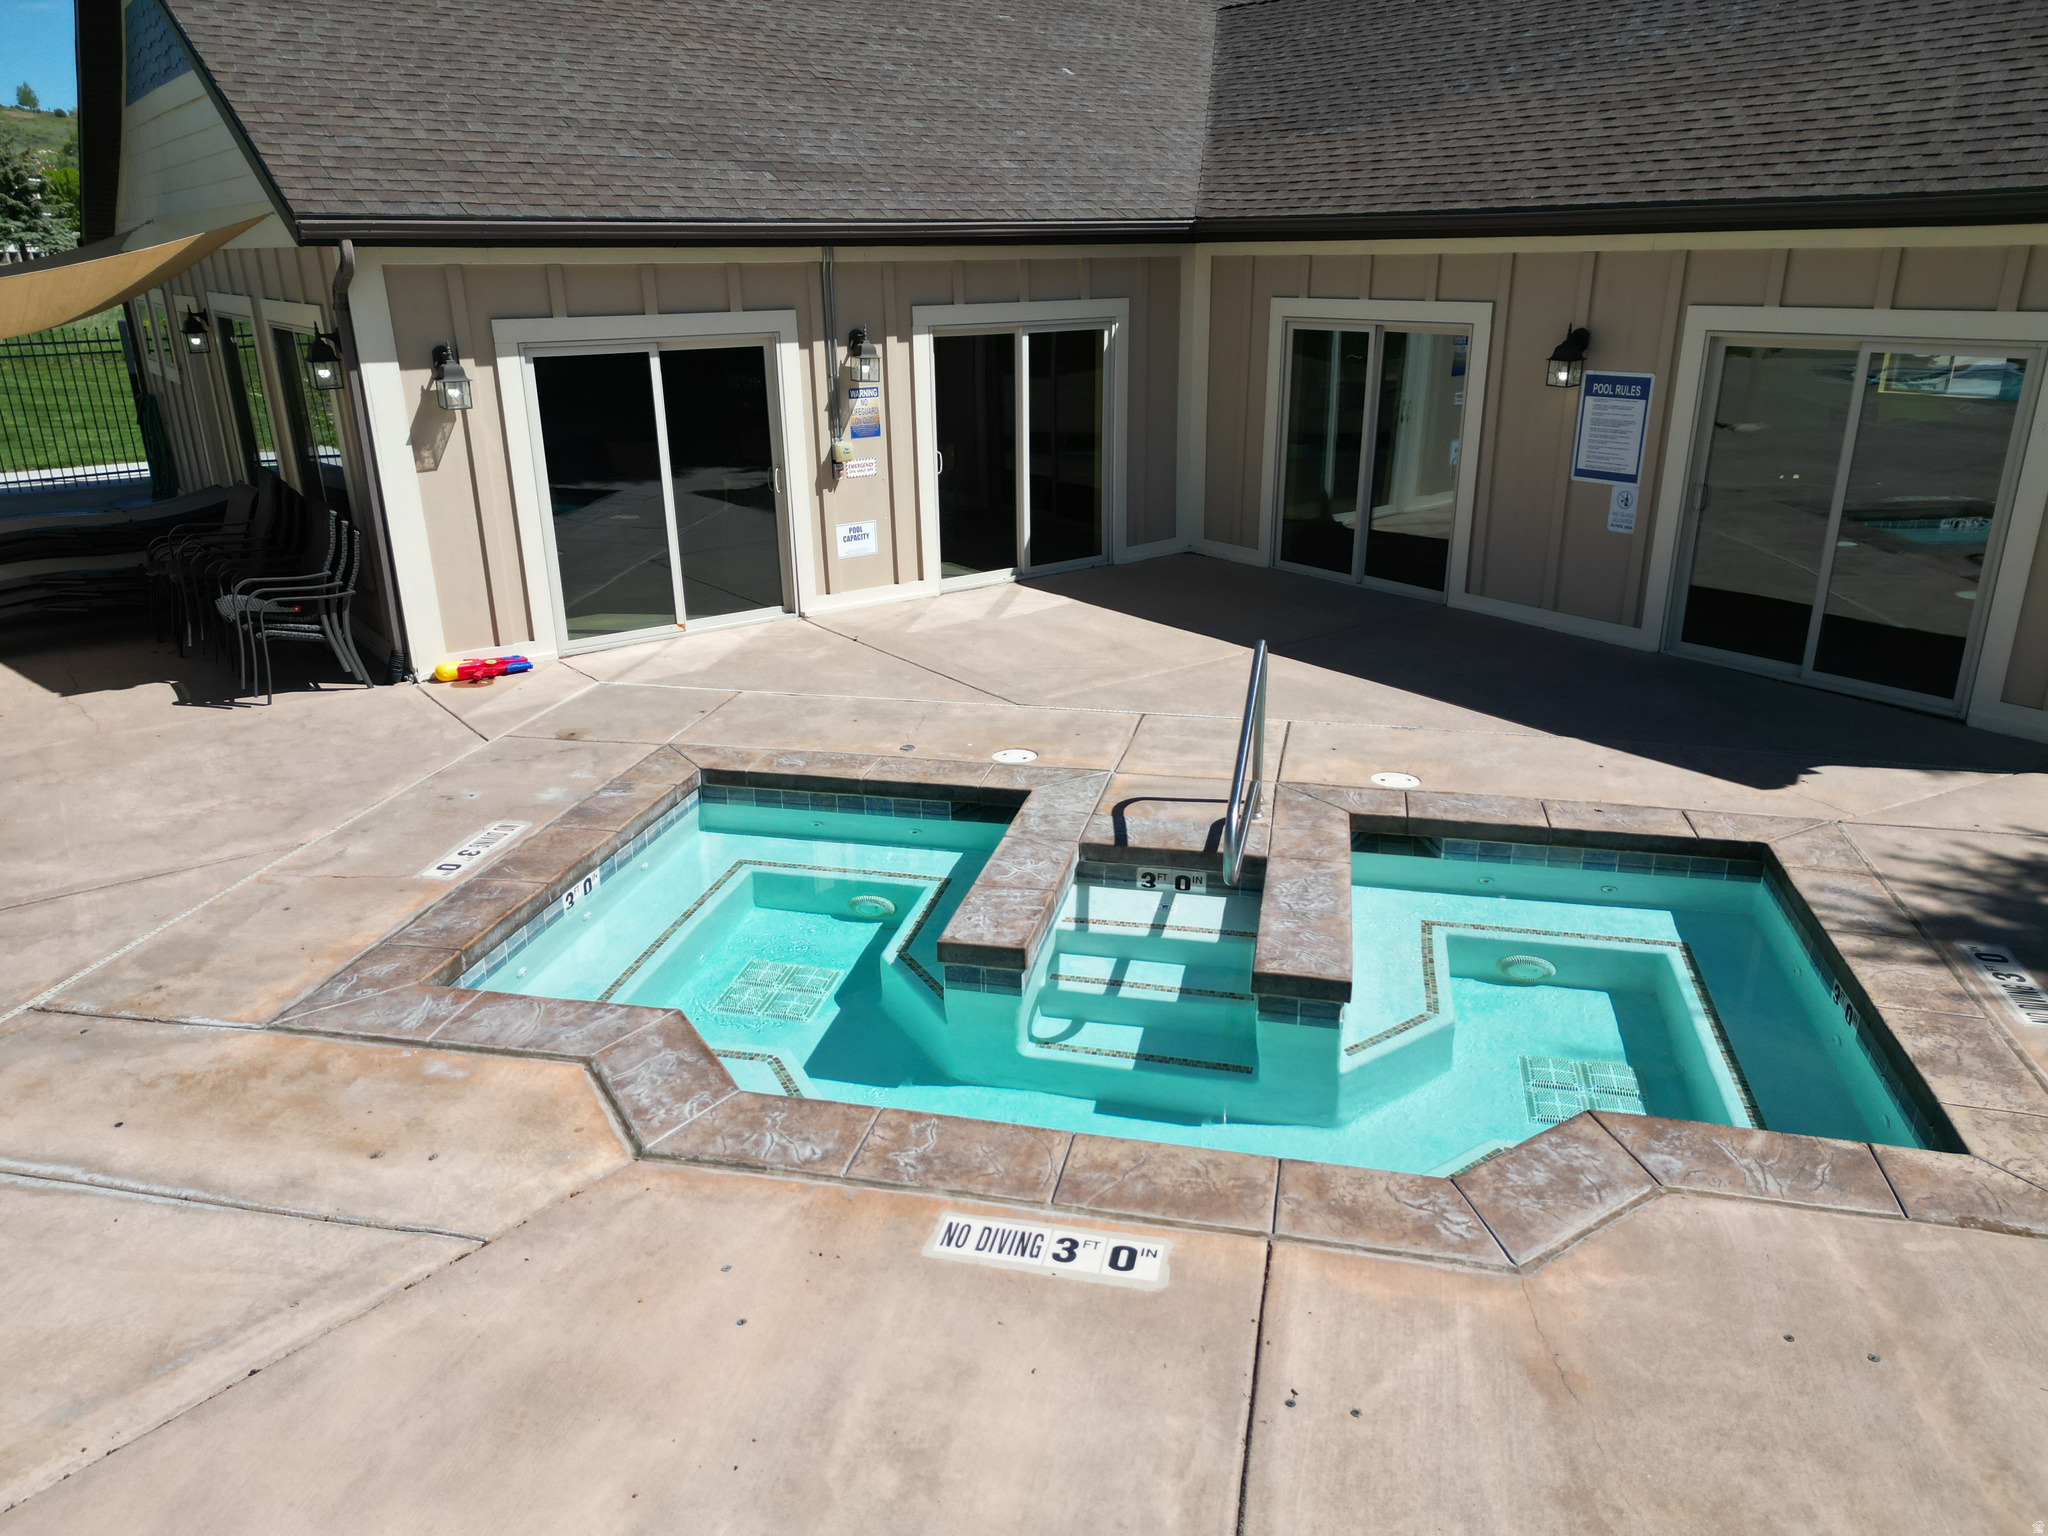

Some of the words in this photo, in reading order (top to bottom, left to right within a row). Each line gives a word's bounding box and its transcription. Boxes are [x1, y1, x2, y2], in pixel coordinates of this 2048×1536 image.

[849, 388, 877, 398] WARNING
[1592, 382, 1613, 395] POOL
[1615, 384, 1641, 396] RULES
[860, 398, 868, 406] NO
[850, 407, 878, 416] LIFEGUARD
[855, 417, 862, 425] ON
[863, 416, 876, 424] DUTY
[849, 526, 862, 534] POOL
[843, 532, 869, 543] CAPACITY
[494, 823, 520, 831] NO
[457, 849, 481, 857] 3
[436, 863, 462, 871] 0
[1141, 872, 1156, 888] 3
[1157, 873, 1168, 881] FT
[1174, 875, 1191, 891] 0
[1192, 876, 1203, 884] IN
[566, 892, 574, 910] 3
[584, 877, 592, 896] 0
[1974, 952, 2009, 963] 0
[1992, 972, 2027, 983] 3
[1833, 984, 1840, 1006] 3
[1845, 1003, 1853, 1027] 0
[939, 1221, 972, 1248] NO
[974, 1226, 1045, 1259] DIVING
[1051, 1237, 1080, 1263] 3
[1082, 1239, 1102, 1251] FT
[1108, 1245, 1139, 1272] 0
[1140, 1247, 1159, 1259] IN
